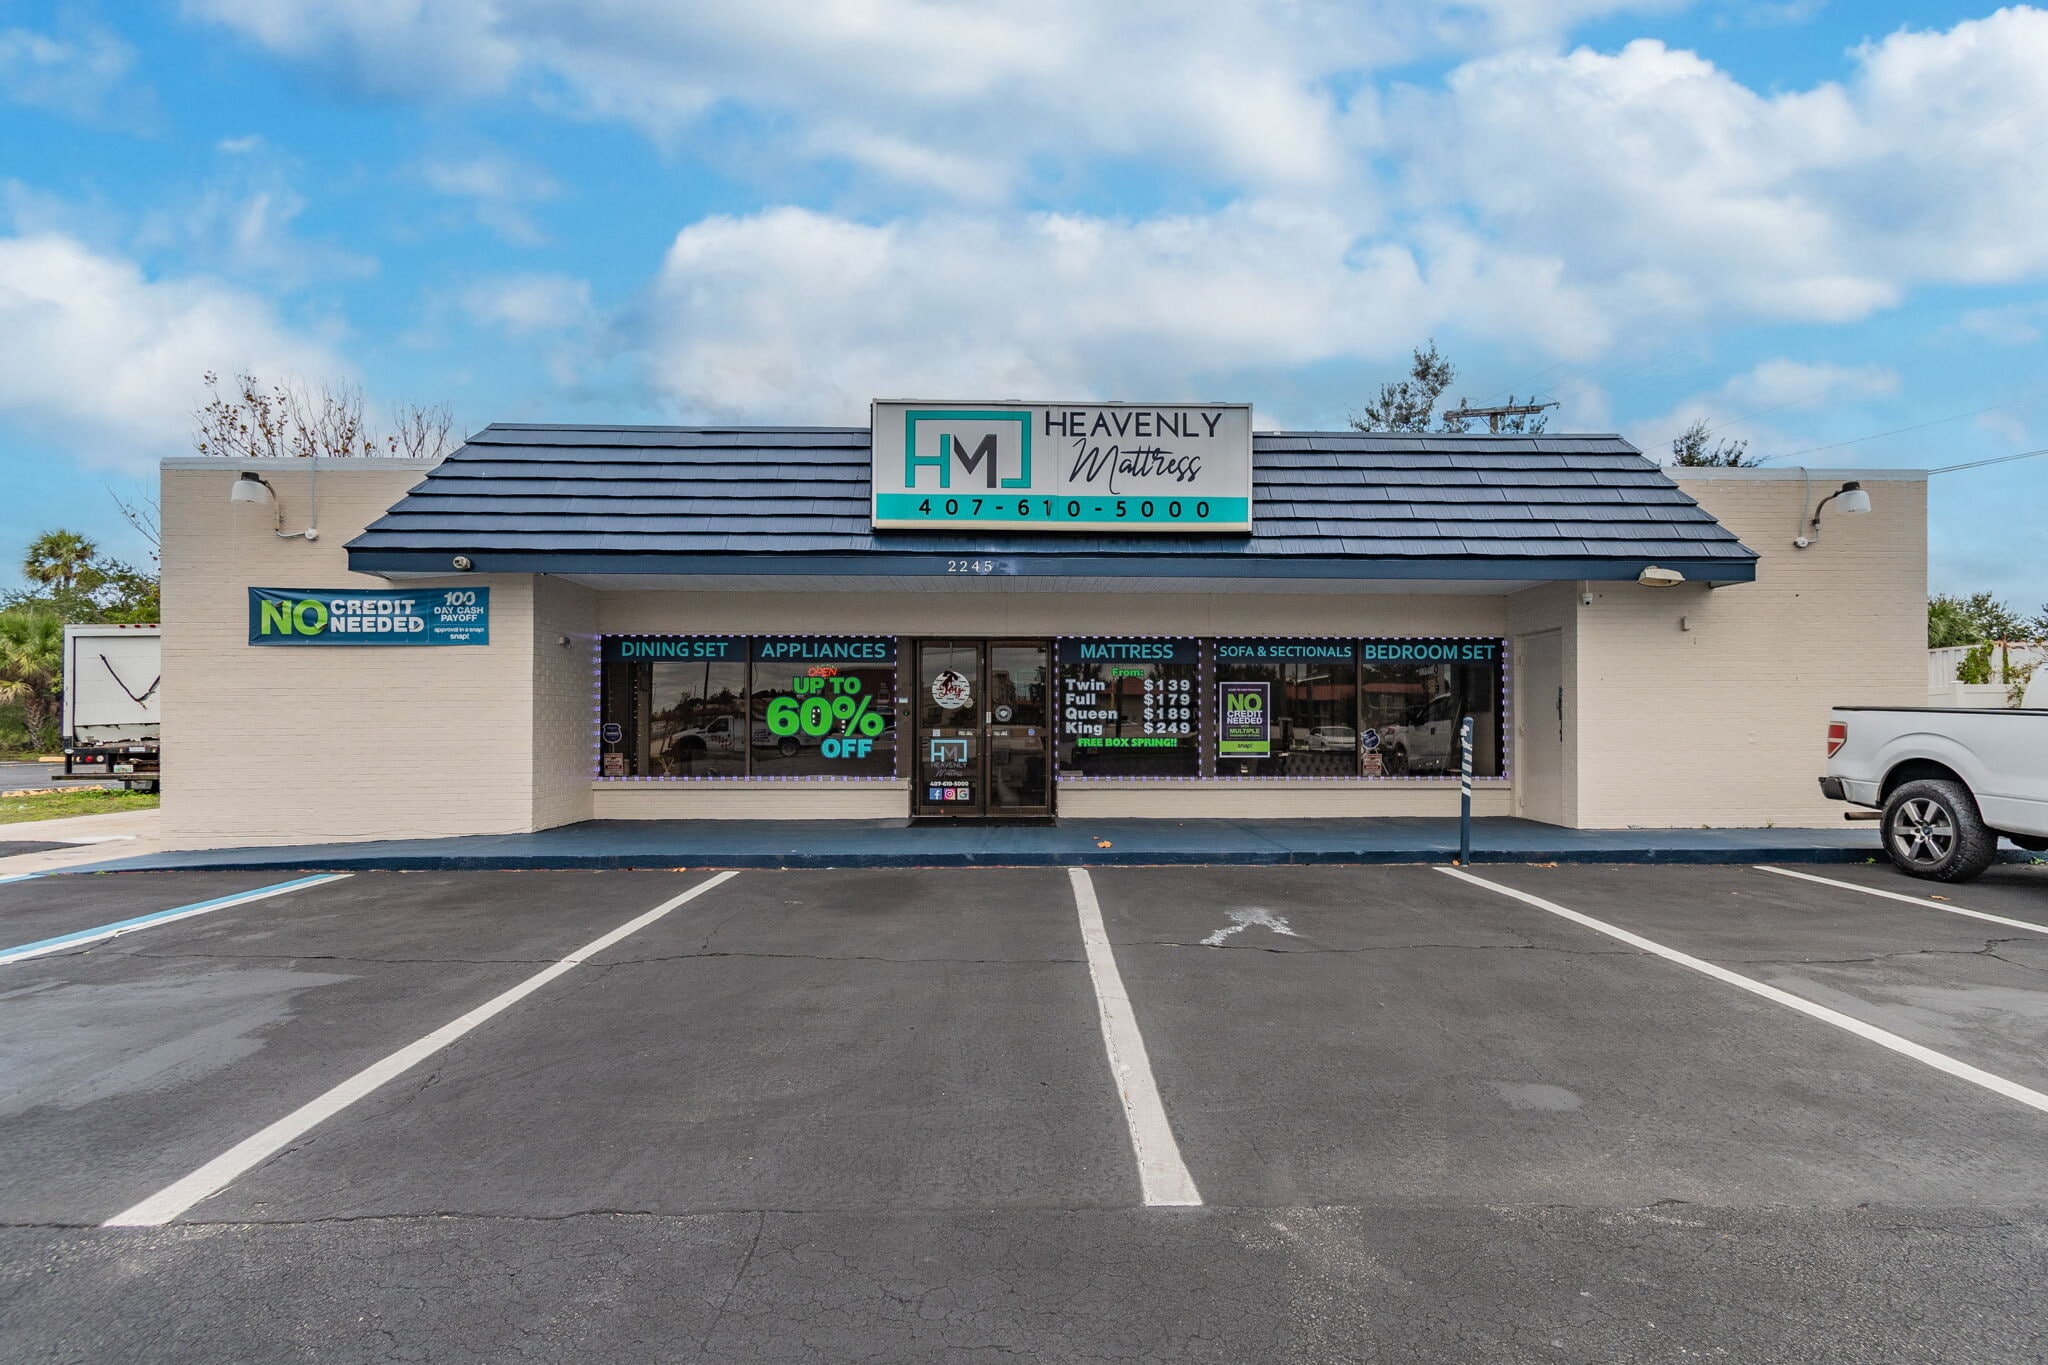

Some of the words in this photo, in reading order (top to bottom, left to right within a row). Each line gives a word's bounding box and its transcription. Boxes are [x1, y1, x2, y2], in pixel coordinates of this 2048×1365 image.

[1045, 411, 1222, 438] HEAVENLY
[1068, 437, 1202, 495] Mattress
[918, 498, 1210, 518] 407-610-5000
[947, 560, 993, 573] 2245
[443, 591, 476, 606] 100
[330, 600, 416, 615] CREDIT
[433, 606, 453, 614] DAY
[456, 606, 484, 614] CASH
[261, 599, 328, 636] NO
[330, 617, 425, 633] NEEDED
[440, 614, 478, 622] PAYOFF
[621, 641, 689, 657] DINING
[693, 641, 728, 657] SET
[761, 642, 887, 658] APPLIANCES
[1080, 644, 1174, 659] MATTRESS
[1219, 646, 1253, 657] SOFA
[1257, 646, 1266, 657] &
[1269, 646, 1352, 657] SECTIONALS
[1365, 644, 1457, 660] BEDROOM
[1462, 644, 1496, 660] SET
[808, 667, 837, 677] OPEN
[1111, 667, 1145, 677] From:
[793, 677, 825, 694] UP
[829, 677, 862, 694] TO
[1065, 679, 1106, 691] Twin
[1143, 679, 1191, 691] $139
[1065, 693, 1096, 705] Full
[1143, 693, 1191, 706] $179
[1227, 693, 1262, 711] NO
[766, 695, 885, 737] 60%
[1065, 707, 1118, 720] Queen
[1143, 707, 1191, 720] $189
[1227, 710, 1263, 718] CREDIT
[1065, 721, 1103, 736] King
[1143, 722, 1191, 735] $249
[820, 738, 873, 758] OFF
[1077, 737, 1103, 748] FREE
[1105, 737, 1129, 748] BOX
[1131, 737, 1178, 748] SPRING!!
